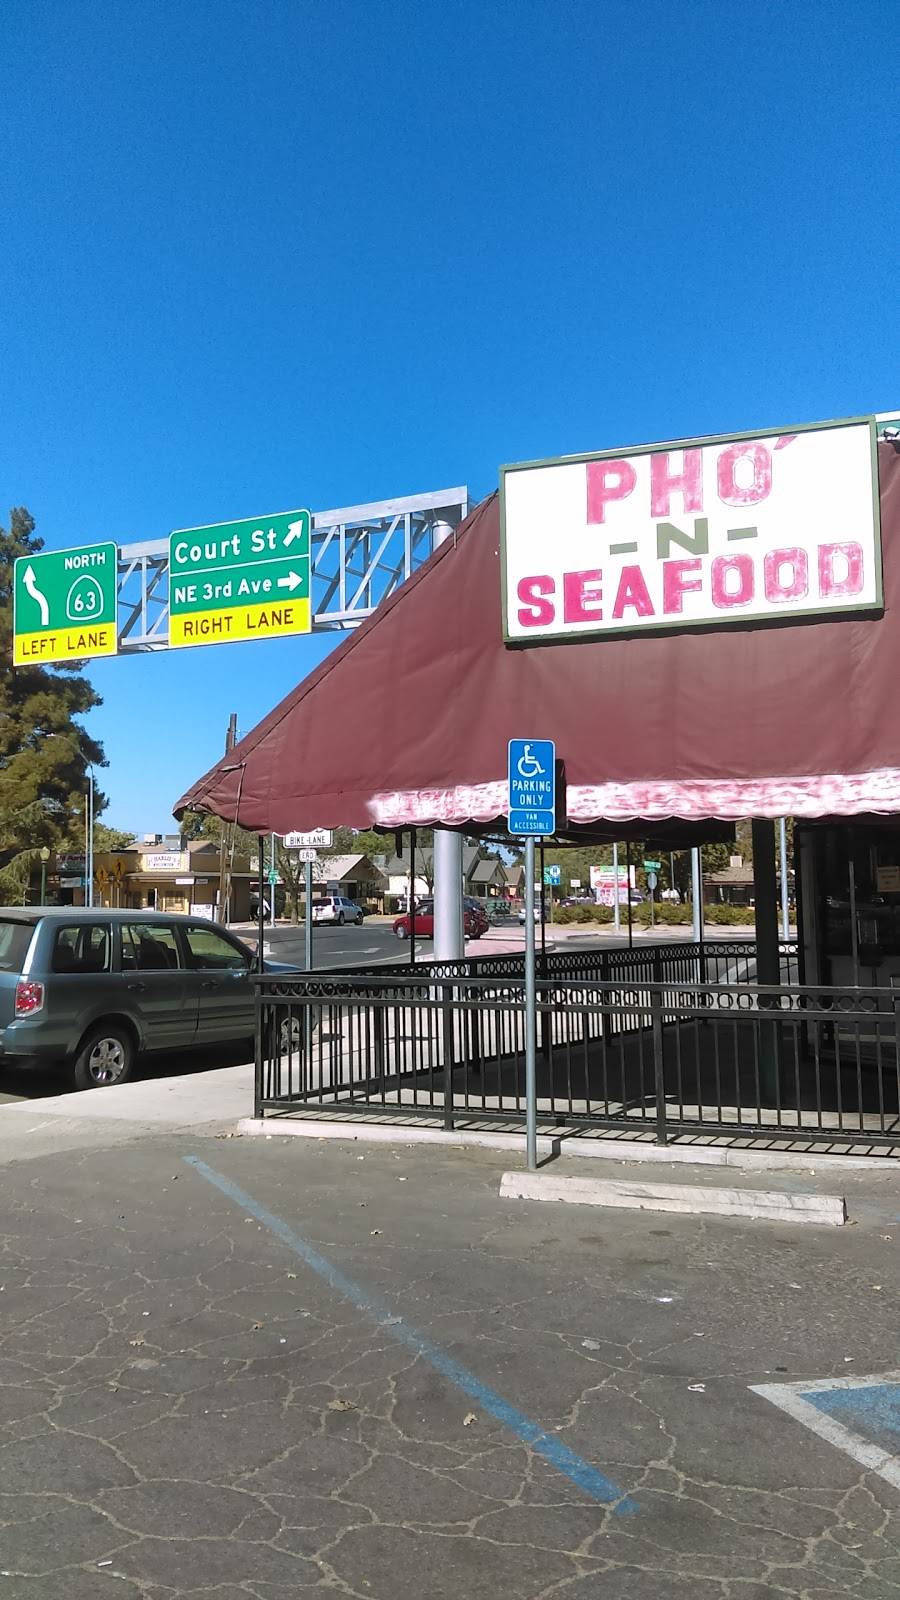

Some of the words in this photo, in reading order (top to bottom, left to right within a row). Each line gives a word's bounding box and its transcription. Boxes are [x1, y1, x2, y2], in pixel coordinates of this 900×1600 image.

[174, 534, 241, 564] Court
[251, 527, 277, 552] St
[64, 551, 106, 571] NORTH
[174, 585, 198, 604] NE
[202, 580, 232, 601] 3rd
[237, 577, 273, 596] Ave
[517, 540, 865, 628] SEAFOOD
[74, 591, 96, 612] 63
[183, 615, 233, 637] RIGHT
[246, 608, 294, 630] LANE
[22, 637, 57, 656] LEFT
[67, 631, 108, 651] LANE
[512, 779, 551, 793] PARKING
[520, 794, 544, 806] ONLY
[514, 822, 549, 830] ACCESSIBLE
[290, 835, 305, 845] BIKE
